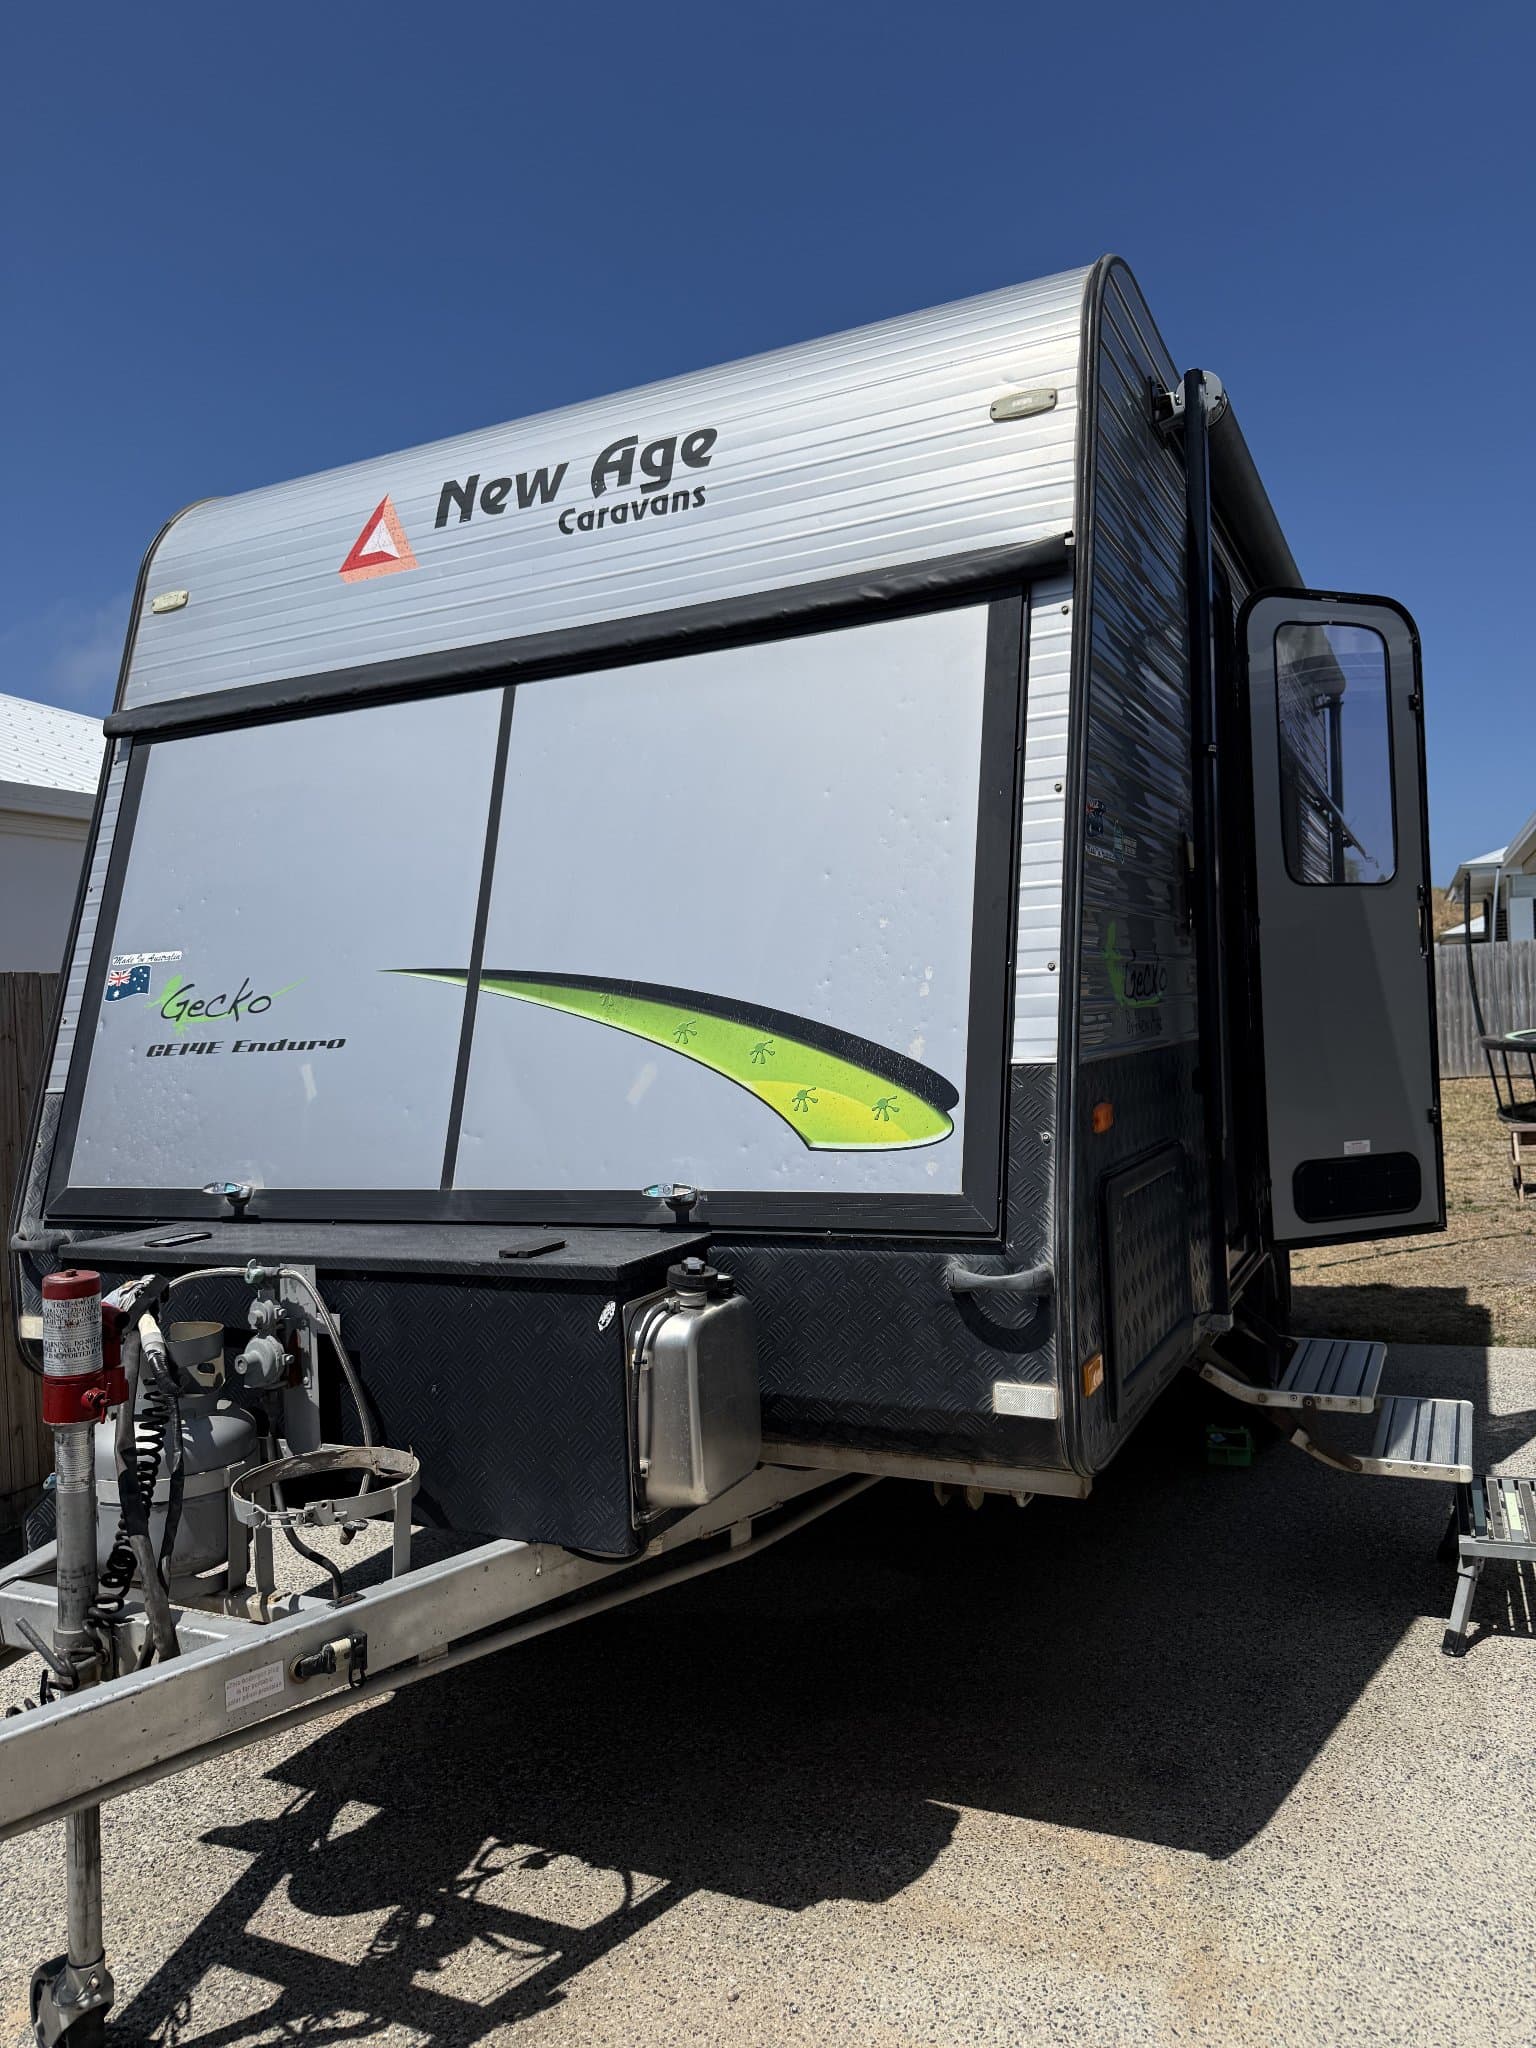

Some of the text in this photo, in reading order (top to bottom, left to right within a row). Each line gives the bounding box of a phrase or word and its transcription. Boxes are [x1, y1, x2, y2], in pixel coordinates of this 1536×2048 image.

[435, 428, 718, 528] New Age
[558, 486, 706, 535] Caravans
[148, 952, 181, 962] Australia
[160, 977, 272, 1022] Gecko
[231, 1038, 347, 1053] Enduro
